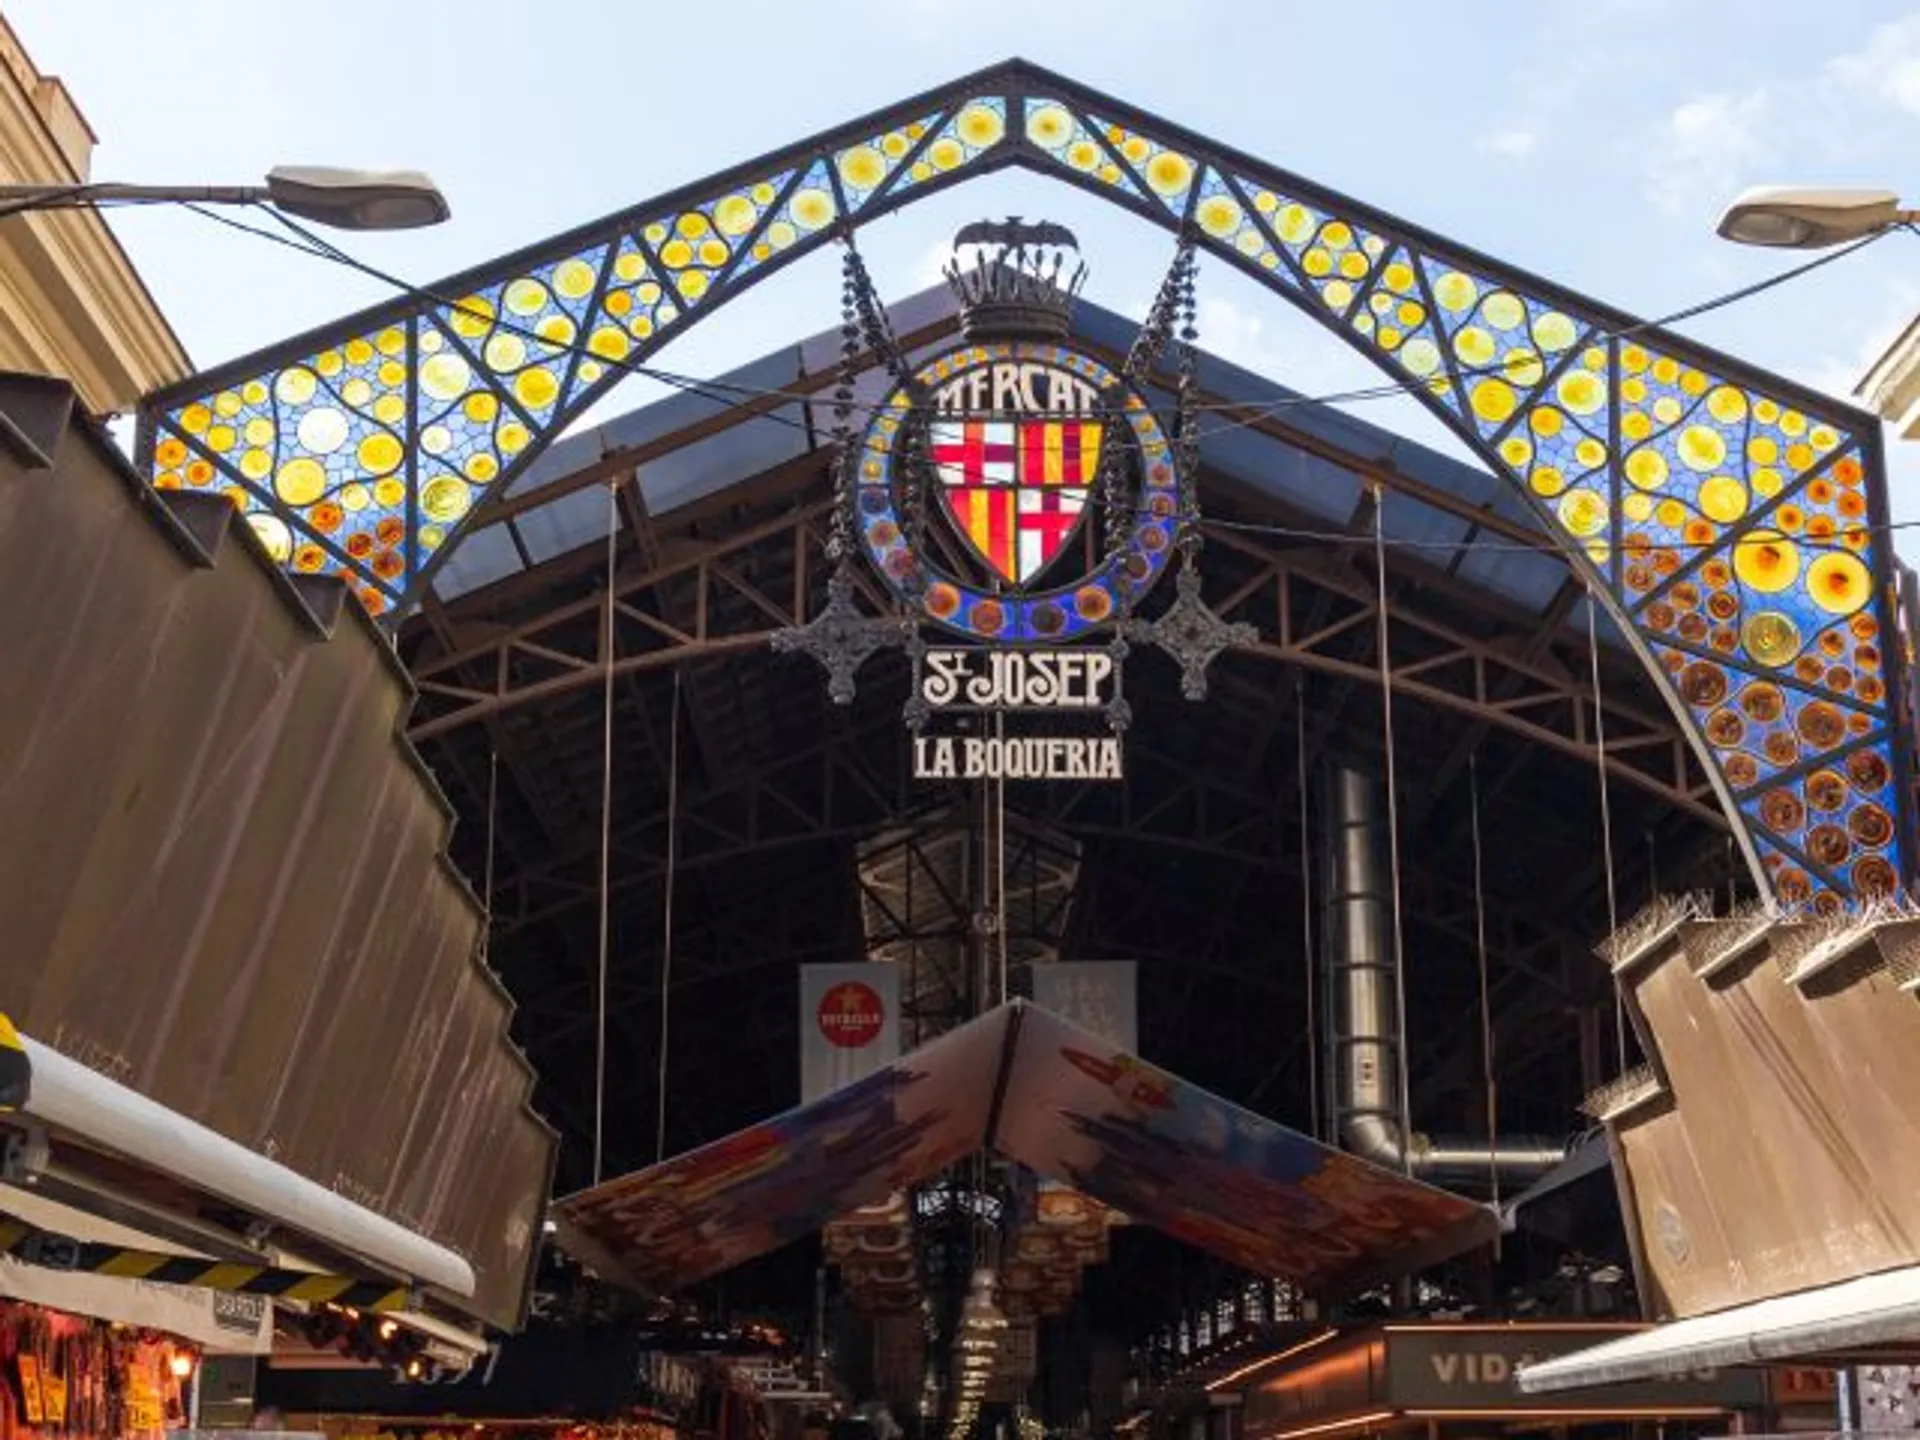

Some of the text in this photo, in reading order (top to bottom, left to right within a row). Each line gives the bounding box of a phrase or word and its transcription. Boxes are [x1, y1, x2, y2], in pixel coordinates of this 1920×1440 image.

[931, 362, 1098, 417] MERCAT
[966, 652, 1111, 705] JOSEP
[914, 737, 1123, 778] LA BOQUERIA
